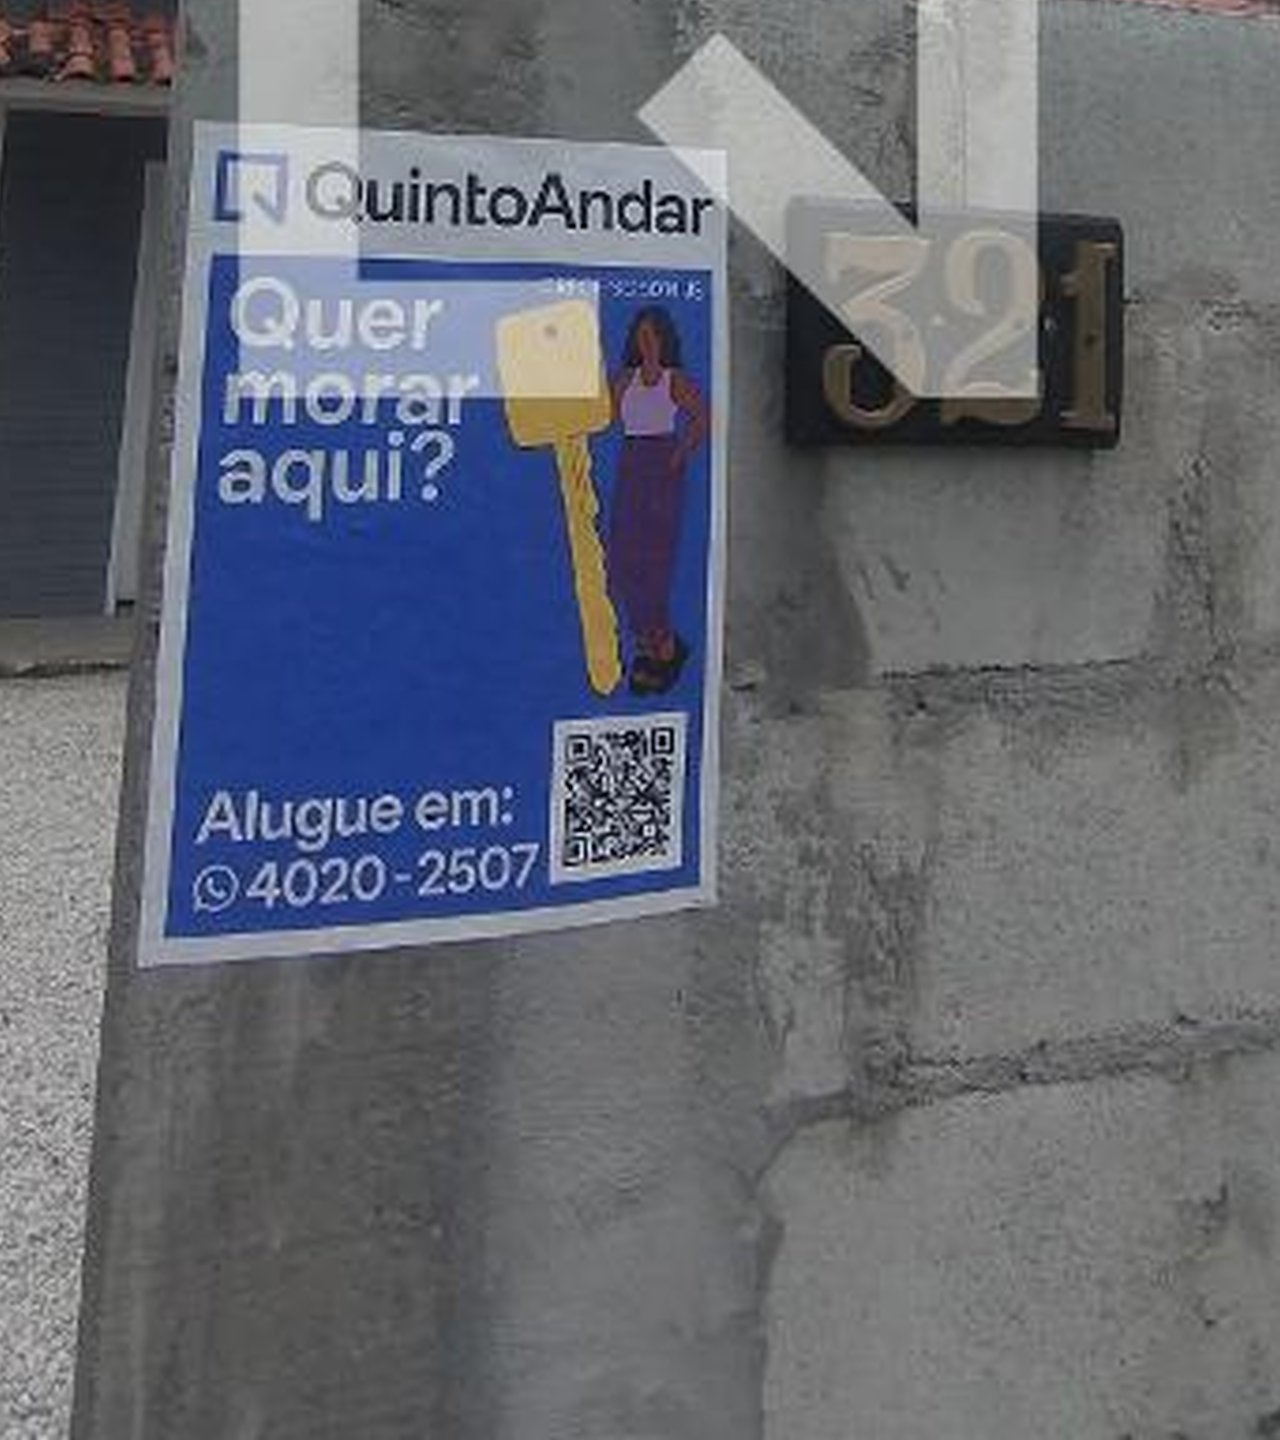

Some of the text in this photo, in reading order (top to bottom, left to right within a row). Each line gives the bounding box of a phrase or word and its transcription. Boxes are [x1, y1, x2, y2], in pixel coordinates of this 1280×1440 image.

[305, 161, 714, 236] QuintoAndar
[230, 275, 445, 352] Quer
[819, 230, 1118, 430] 321
[223, 369, 479, 426] morar
[218, 431, 456, 522] aqui?
[195, 785, 514, 850] Alugue em:
[246, 843, 541, 909] 4020-2507
